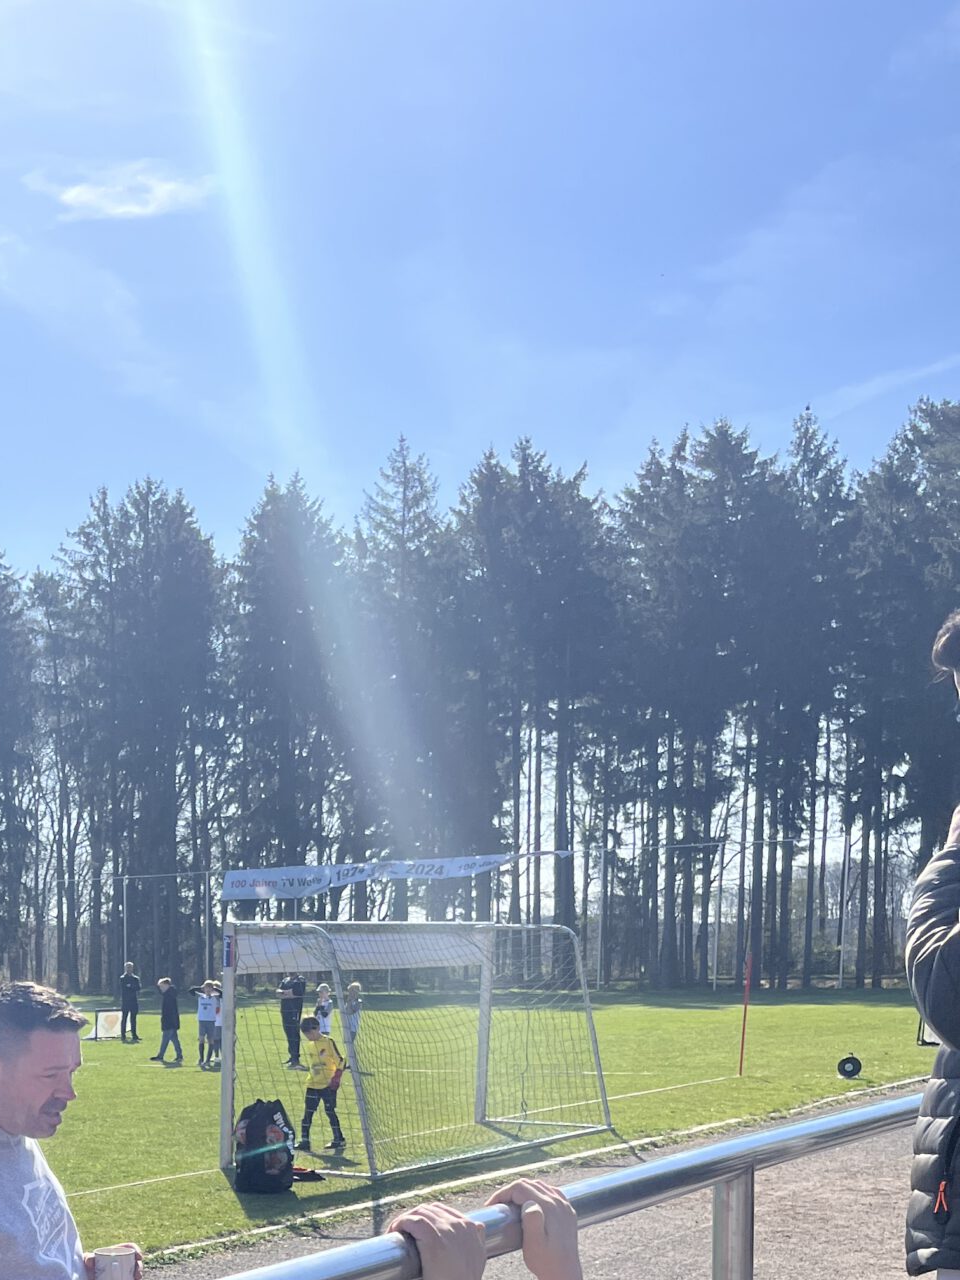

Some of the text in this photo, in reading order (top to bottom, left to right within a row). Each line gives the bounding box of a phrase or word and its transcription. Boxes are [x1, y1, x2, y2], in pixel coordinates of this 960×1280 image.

[407, 862, 445, 876] 2024
[230, 879, 247, 890] 100
[280, 878, 296, 889] TV
